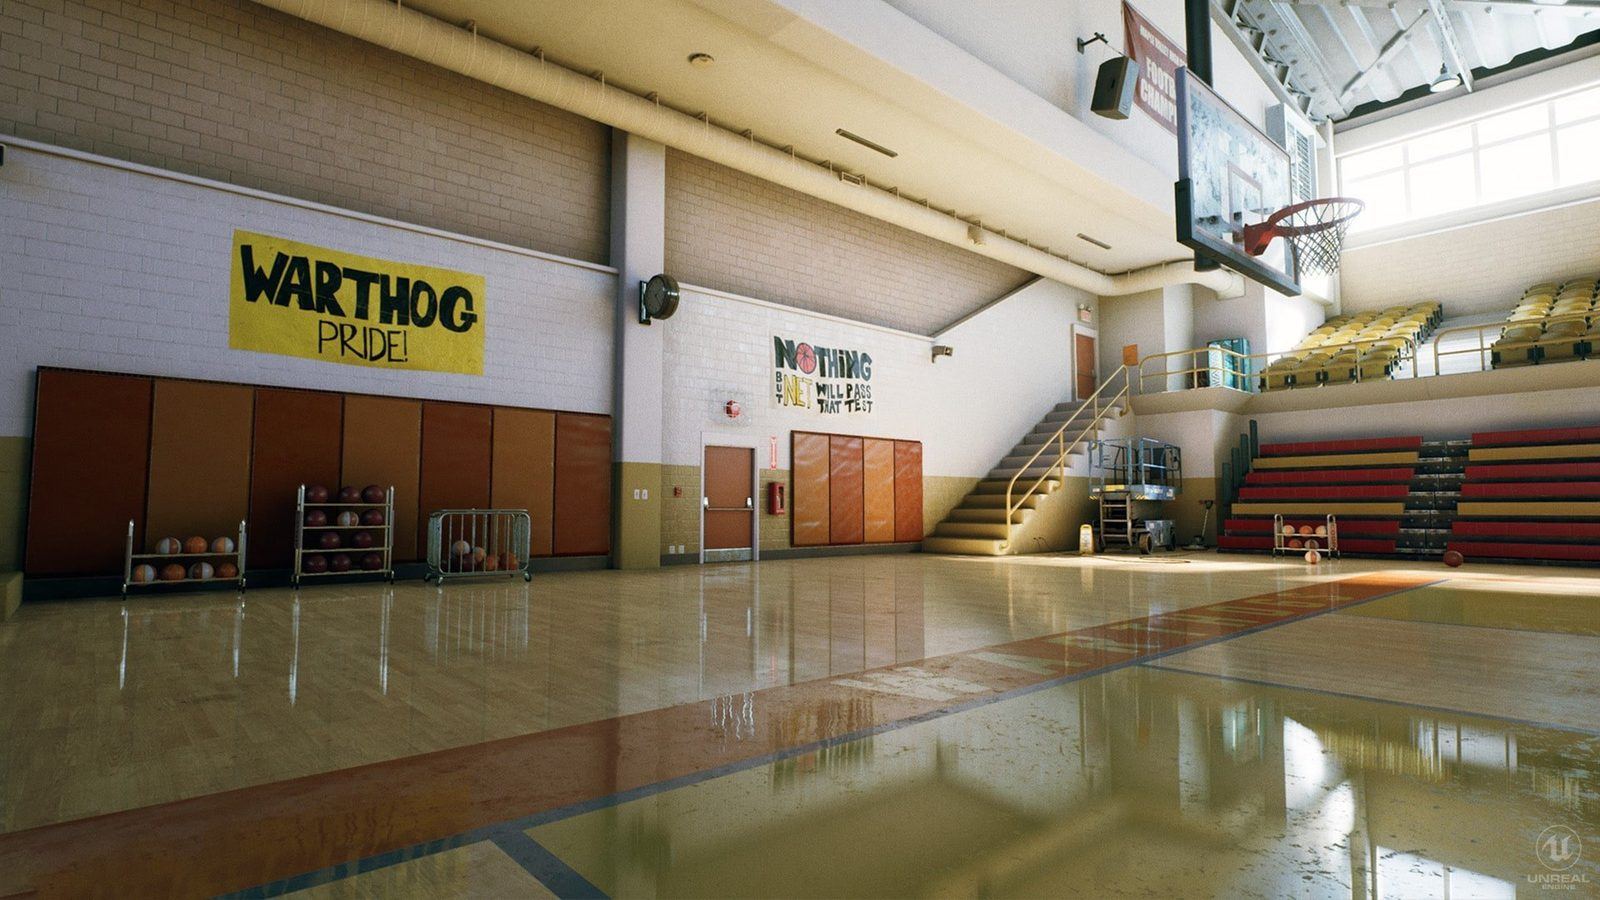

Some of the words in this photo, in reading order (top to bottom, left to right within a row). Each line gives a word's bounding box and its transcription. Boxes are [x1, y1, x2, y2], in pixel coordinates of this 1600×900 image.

[240, 244, 478, 333] WARTHOG
[318, 319, 408, 362] PRIDE!
[775, 371, 783, 404] BUT
[783, 374, 813, 410] NET
[815, 381, 844, 400] WILL
[846, 383, 872, 399] PASS
[817, 398, 842, 414] THAT
[844, 399, 873, 413] TEST
